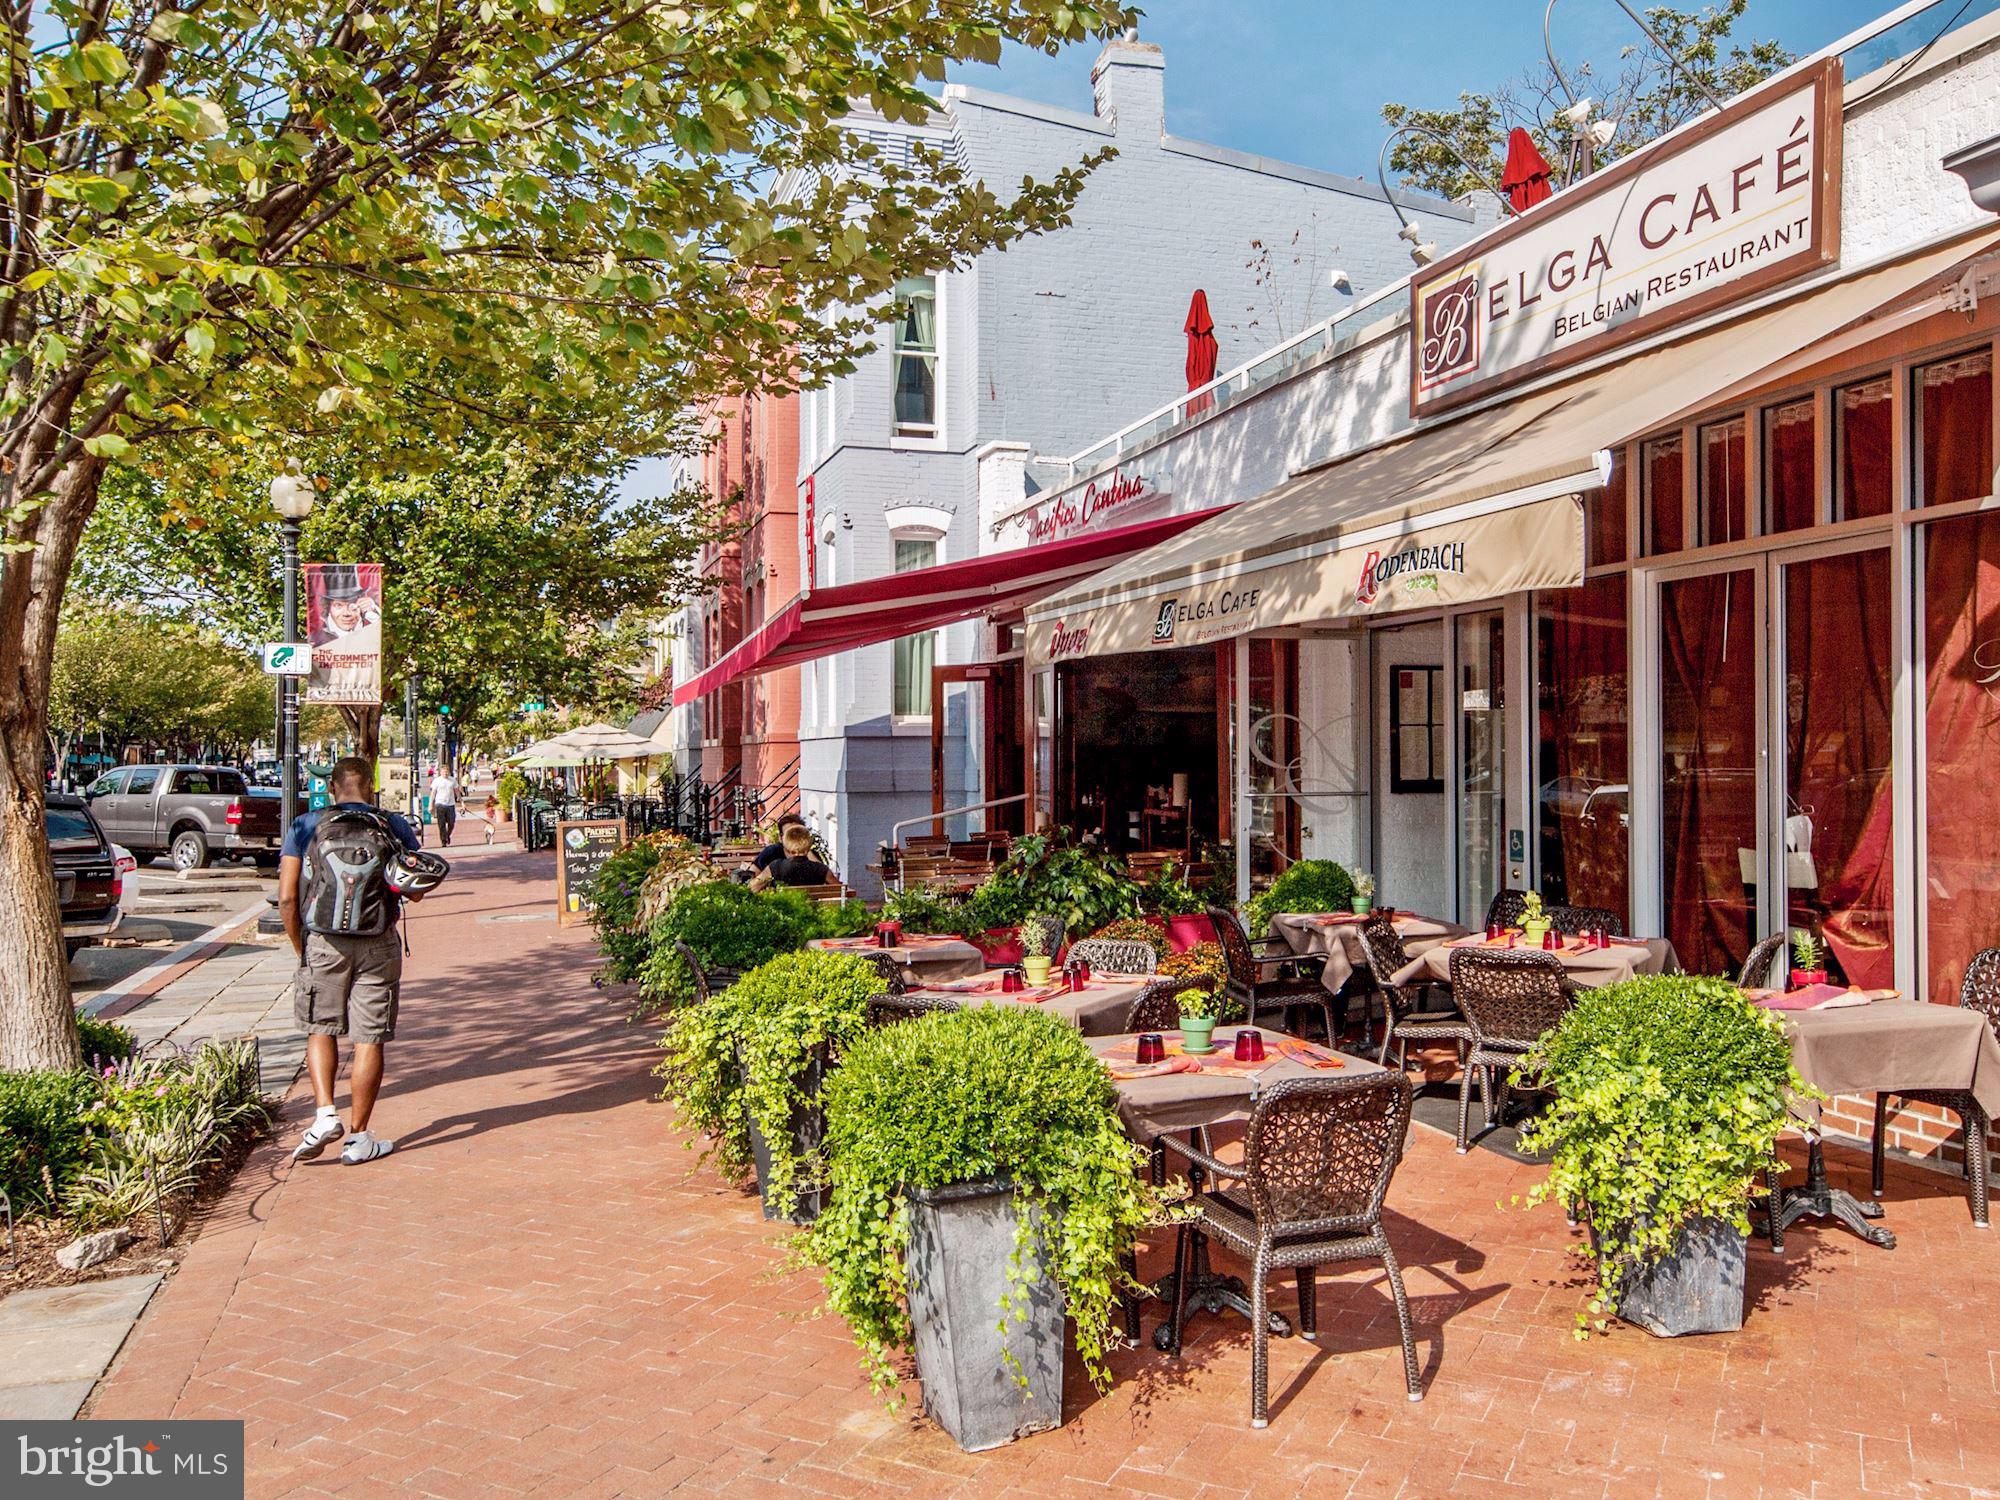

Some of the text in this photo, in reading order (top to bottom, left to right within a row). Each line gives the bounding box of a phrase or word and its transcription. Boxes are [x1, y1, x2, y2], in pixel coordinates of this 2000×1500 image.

[1420, 115, 1810, 374] BELGA CAFÉ
[1554, 216, 1809, 339] BELGIAN RESTAURANT
[1082, 466, 1145, 527] Cantina
[1355, 542, 1465, 605] RODENBACH
[1154, 601, 1214, 638] BELGA
[312, 653, 379, 662] GOVERNMENT
[314, 778, 325, 792] P
[568, 862, 587, 874] Take
